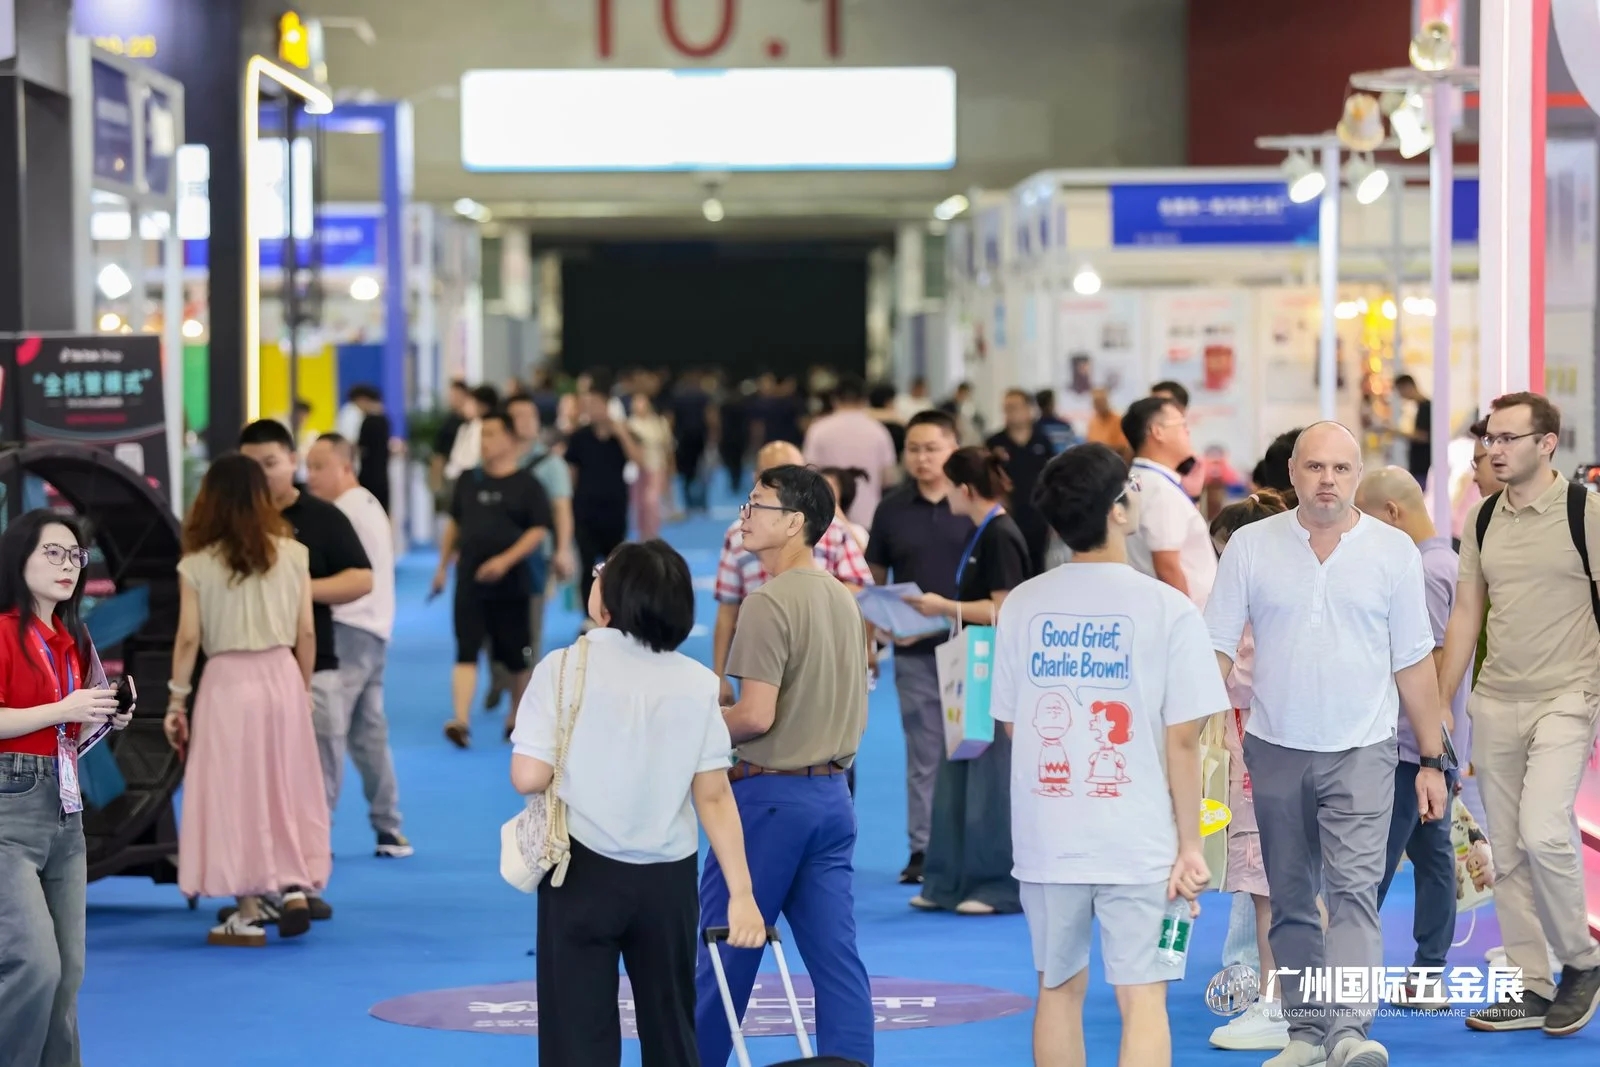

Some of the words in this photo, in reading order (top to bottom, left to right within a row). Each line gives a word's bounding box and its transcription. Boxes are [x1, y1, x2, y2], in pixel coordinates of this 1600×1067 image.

[1042, 620, 1080, 648] Good
[1082, 622, 1121, 651] Grief,
[1031, 651, 1078, 677] Charlie
[1081, 652, 1129, 679] Brown!
